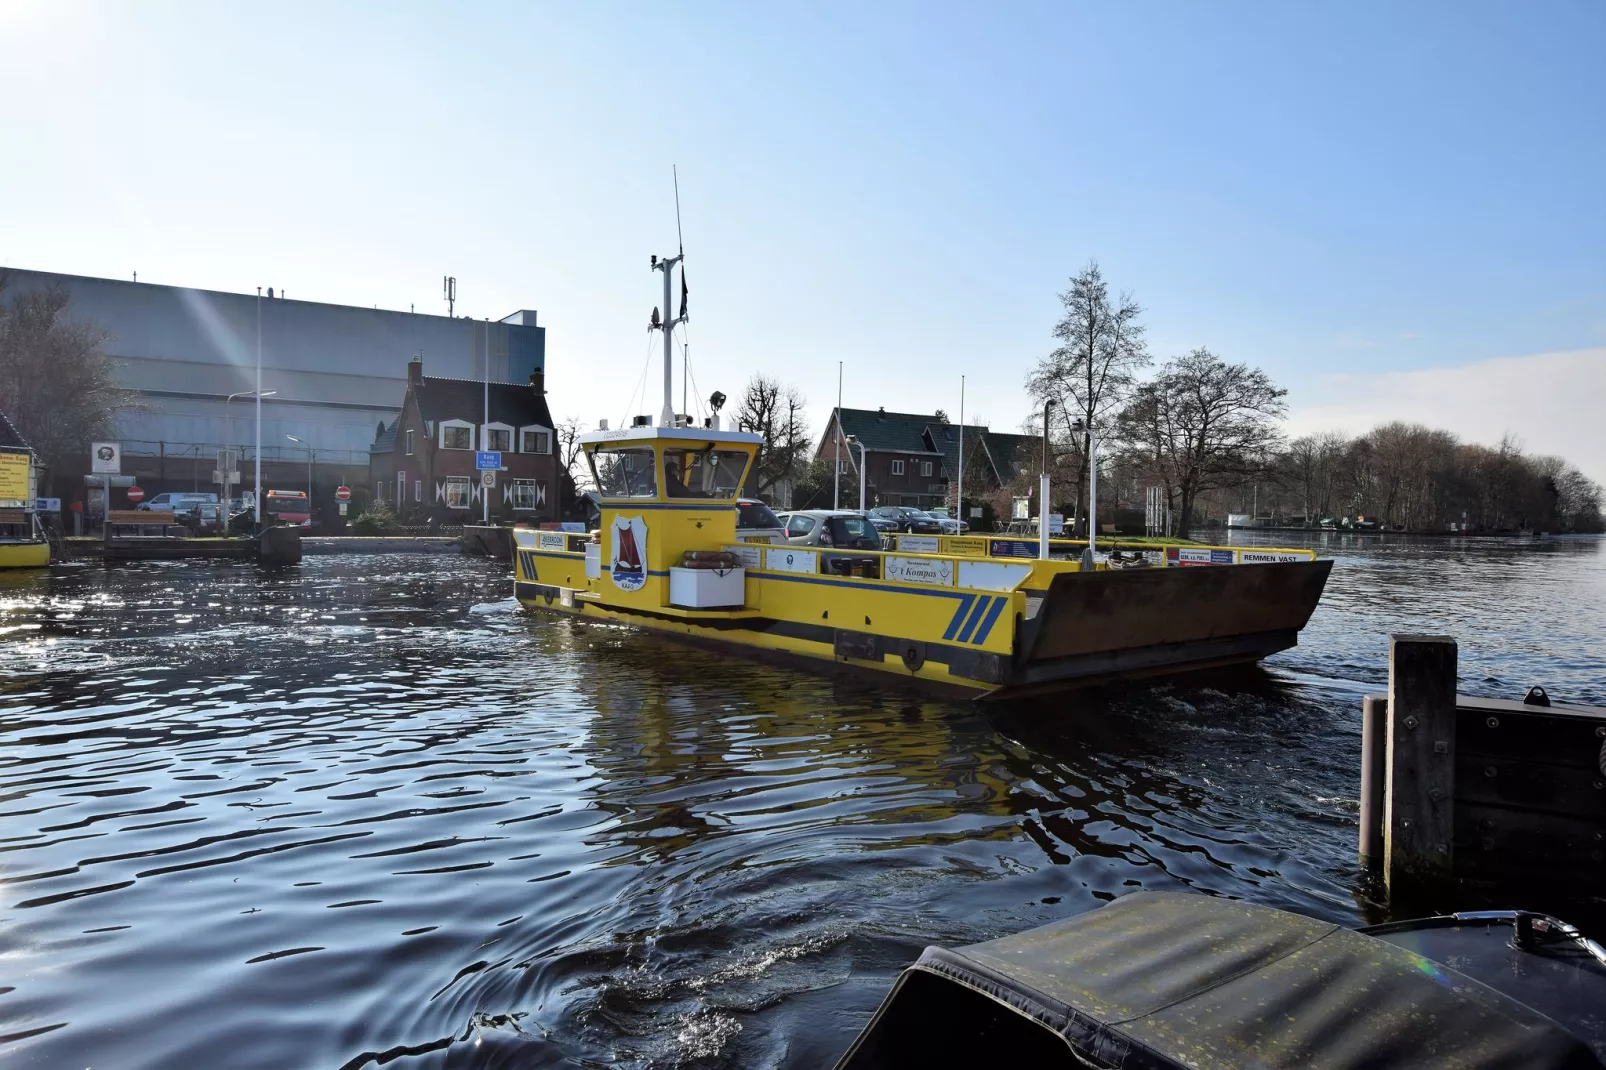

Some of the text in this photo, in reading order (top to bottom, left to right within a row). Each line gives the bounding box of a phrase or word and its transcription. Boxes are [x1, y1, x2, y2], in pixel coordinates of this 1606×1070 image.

[1244, 554, 1297, 563] REMMEN VAST
[905, 567, 937, 578] Kompas
